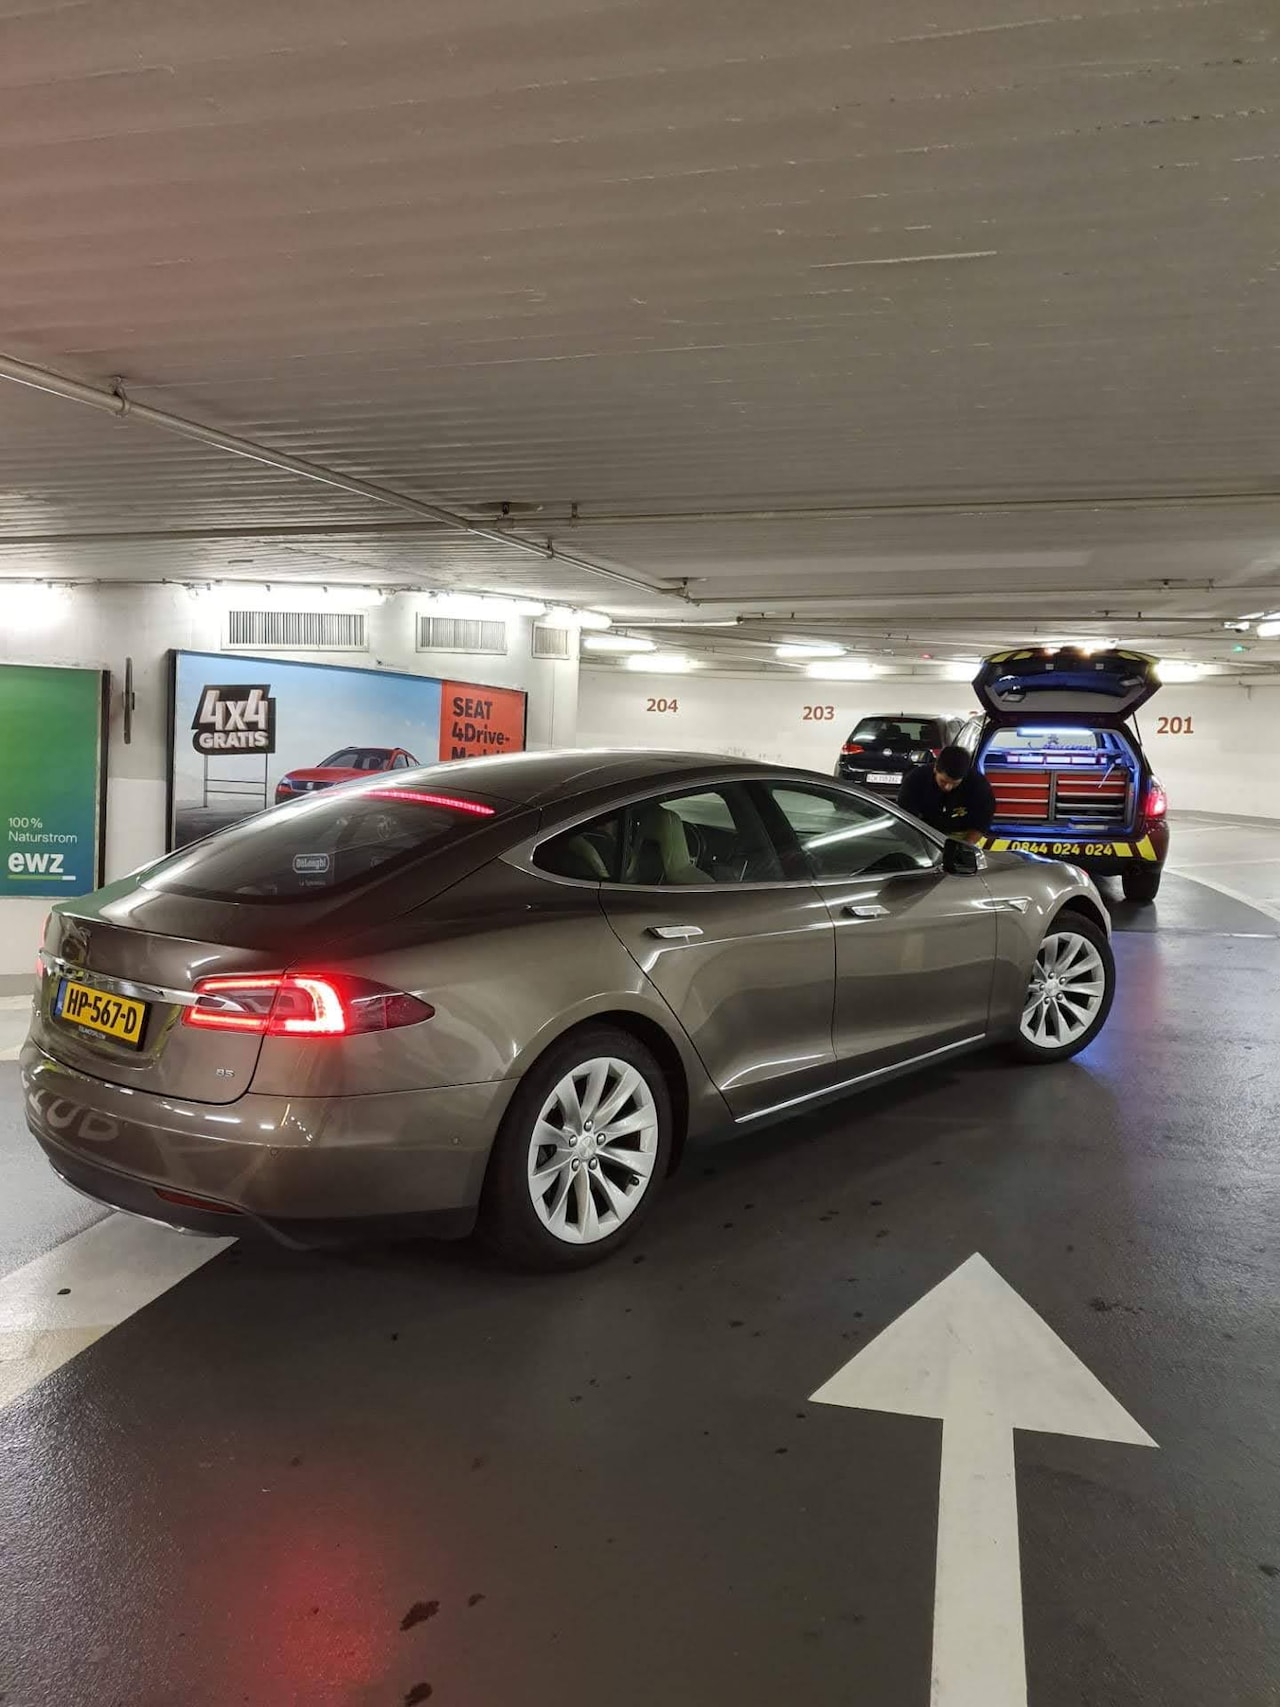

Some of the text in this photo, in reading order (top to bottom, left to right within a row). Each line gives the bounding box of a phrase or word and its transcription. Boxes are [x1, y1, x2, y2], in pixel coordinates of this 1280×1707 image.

[199, 689, 268, 731] 4x4
[452, 696, 493, 720] SEAT
[646, 698, 679, 713] 204
[802, 705, 835, 720] 203
[451, 721, 511, 745] 4Drive-
[1157, 716, 1194, 734] 201
[198, 731, 268, 749] GRATIS
[8, 831, 78, 844] Naturstrom
[1011, 841, 1113, 856] 0844 024 024
[8, 852, 64, 873] ewz
[66, 988, 137, 1034] HP-567-D
[216, 1068, 235, 1077] 85
